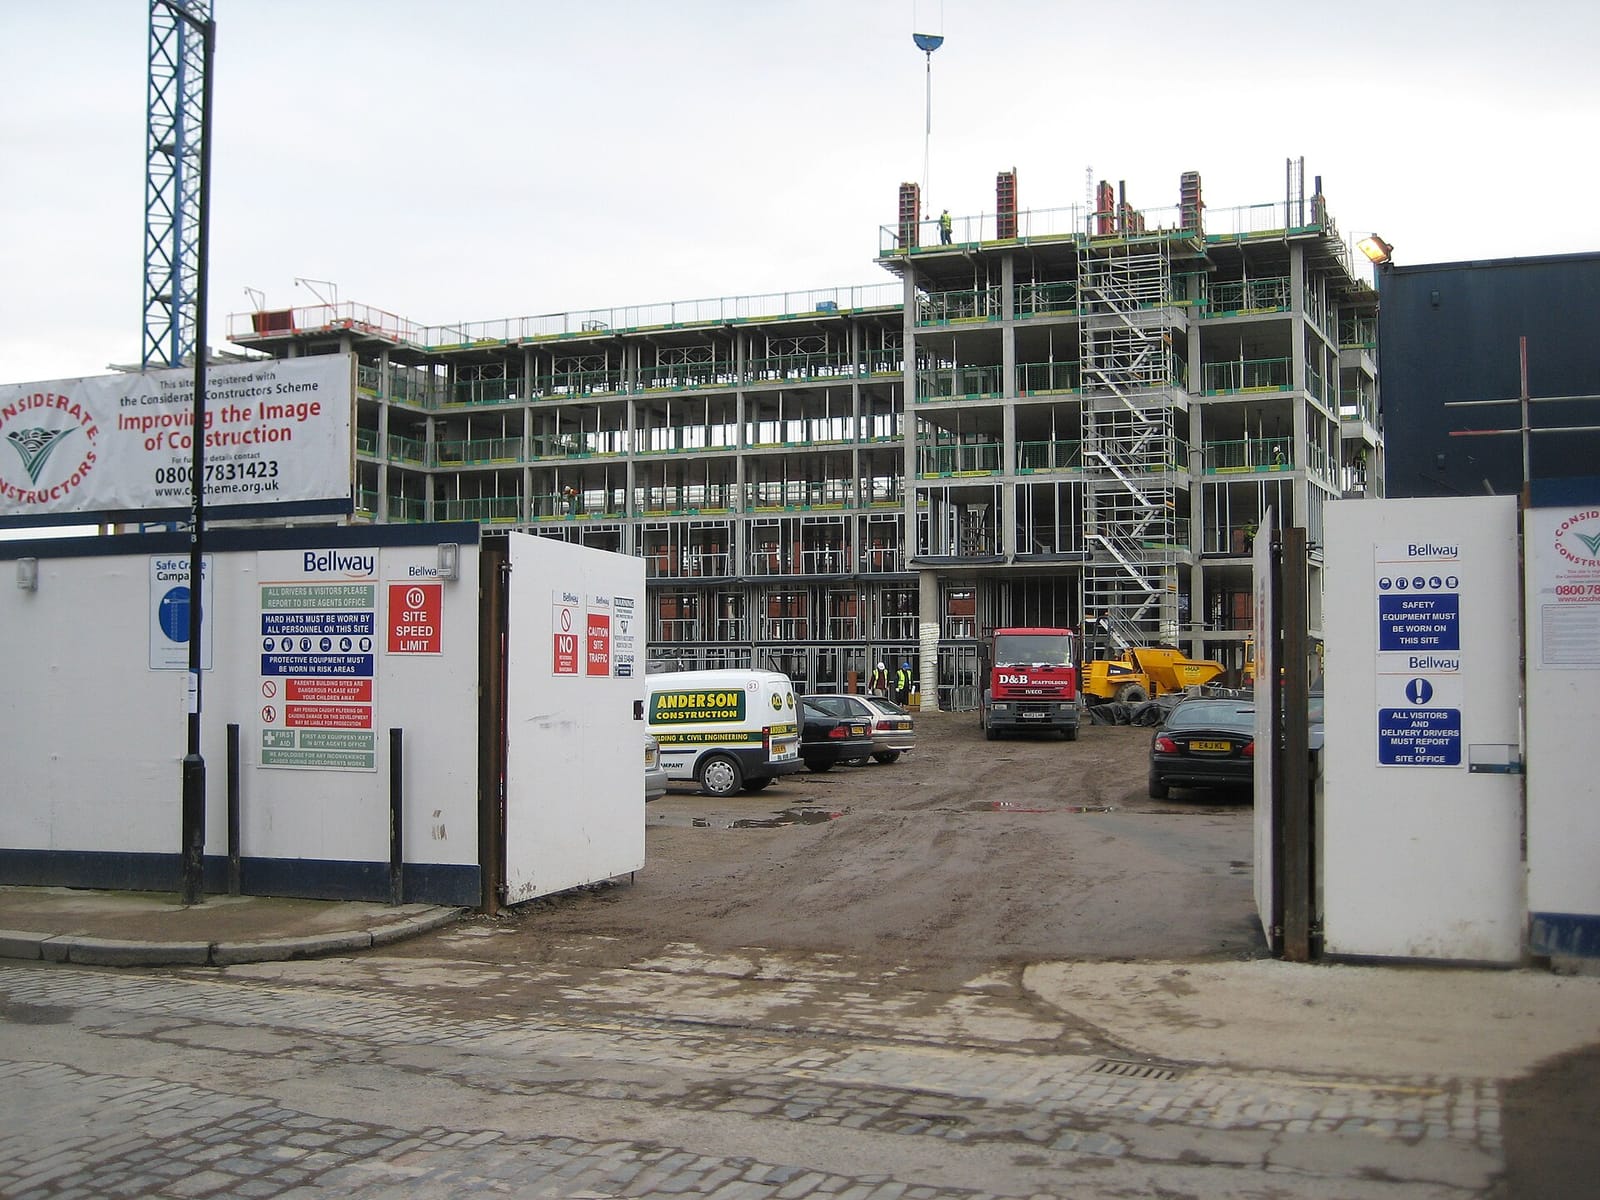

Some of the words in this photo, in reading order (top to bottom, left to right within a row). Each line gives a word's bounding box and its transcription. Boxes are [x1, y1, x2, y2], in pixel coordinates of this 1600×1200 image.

[208, 373, 253, 387] registered
[255, 371, 276, 382] with
[120, 396, 138, 407] the
[140, 391, 194, 405] Considerat
[276, 382, 319, 394] Scheme
[0, 393, 99, 440] NSIDERATE
[220, 405, 251, 423] the
[259, 401, 321, 422] Image
[144, 432, 163, 451] of
[168, 425, 292, 449] Costruction
[234, 452, 260, 460] contact
[204, 460, 278, 482] 7831423
[1408, 544, 1458, 558] Bellway
[156, 560, 177, 570] Safe
[178, 560, 207, 570] Cre
[304, 550, 374, 576] Bellway
[408, 566, 437, 576] Bellwa
[156, 572, 205, 583] Campan
[268, 588, 280, 596] ALL
[281, 587, 307, 596] DRIVERS
[308, 587, 313, 595] &
[314, 586, 342, 595] VISITORS
[343, 586, 368, 595] PLEASE
[1555, 585, 1585, 595] 0800
[268, 599, 292, 607] REPORT
[293, 599, 302, 607] TO
[302, 599, 316, 607] SITE
[317, 599, 342, 607] AGENTS
[343, 598, 366, 606] OFFICE
[409, 593, 421, 603] 10
[1402, 601, 1435, 609] SAFETY
[265, 615, 285, 623] HARD
[286, 615, 304, 623] HATS
[305, 615, 325, 623] MUST
[336, 615, 360, 623] WORN
[360, 614, 370, 622] BY
[402, 611, 427, 622] SITE
[267, 625, 280, 633] ALL
[281, 625, 322, 633] PERSONNEL
[324, 625, 334, 633] ON
[336, 625, 351, 633] THIS
[353, 624, 369, 633] SITE
[395, 625, 433, 636] SPEED
[588, 626, 608, 637] CAUTION
[400, 640, 429, 651] LIMIT
[559, 635, 573, 653] NO
[593, 640, 604, 650] SITE
[588, 653, 608, 663] TRAFFIC
[1409, 656, 1459, 671] Bellway
[278, 665, 288, 673] BE
[288, 665, 308, 673] WORN
[309, 665, 316, 673] IN
[998, 674, 1028, 684] D&B
[657, 693, 738, 708] ANDERSON
[656, 710, 737, 719] CONSTRUCTION
[1423, 729, 1459, 737] DRIVERS
